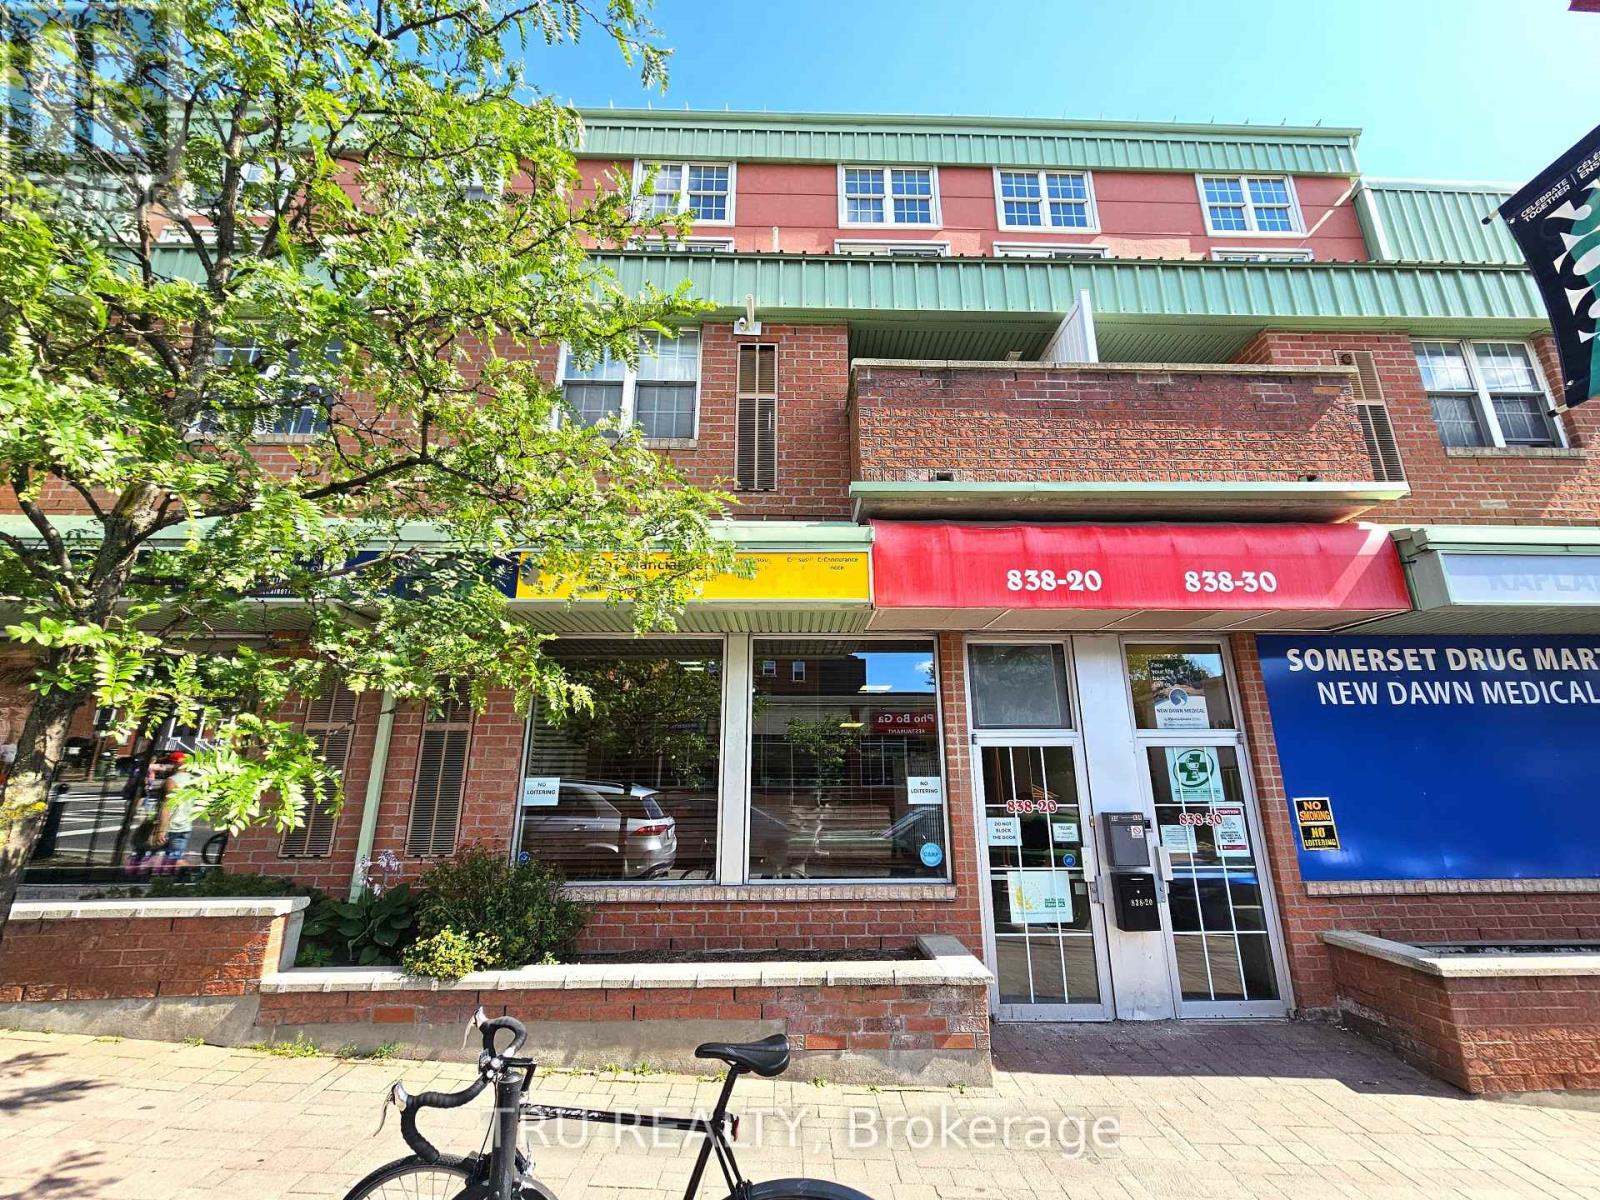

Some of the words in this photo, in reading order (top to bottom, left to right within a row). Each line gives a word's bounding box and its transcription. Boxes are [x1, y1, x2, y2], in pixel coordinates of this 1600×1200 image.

[1579, 158, 1600, 180] ENS
[1520, 177, 1569, 218] CELEBRATE
[1523, 183, 1571, 223] TOGETHER
[1006, 569, 1103, 592] 838-20
[1184, 570, 1278, 593] 838-30
[1489, 574, 1600, 592] KAPLA
[1286, 648, 1437, 671] SOMERSET
[1445, 648, 1529, 671] DRUG
[1317, 681, 1378, 705] NEW
[1387, 681, 1475, 705] DAWN
[1481, 680, 1600, 704] MEDICAL
[1006, 800, 1058, 814] 838-20
[1299, 810, 1331, 821] SMOKING
[1303, 801, 1322, 811] NO
[1178, 812, 1223, 827] 838-30
[1304, 838, 1337, 847] LOITERING
[1311, 827, 1326, 838] NO
